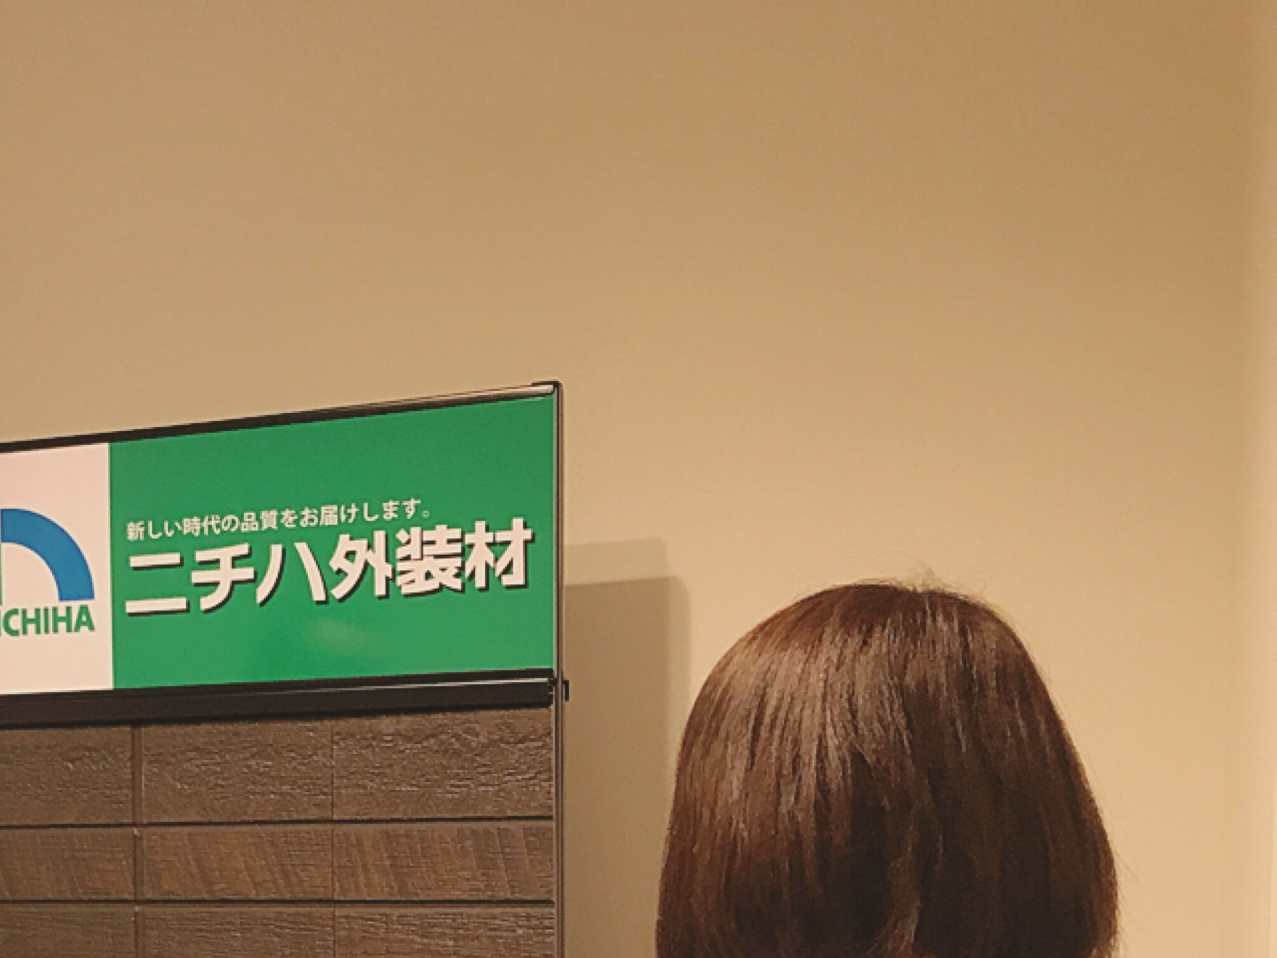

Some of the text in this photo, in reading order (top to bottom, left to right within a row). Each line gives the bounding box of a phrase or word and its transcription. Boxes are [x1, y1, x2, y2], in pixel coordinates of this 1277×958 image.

[126, 498, 430, 541] 新しい時代の品質をお届けします。
[125, 517, 535, 617] ニチハ外装材
